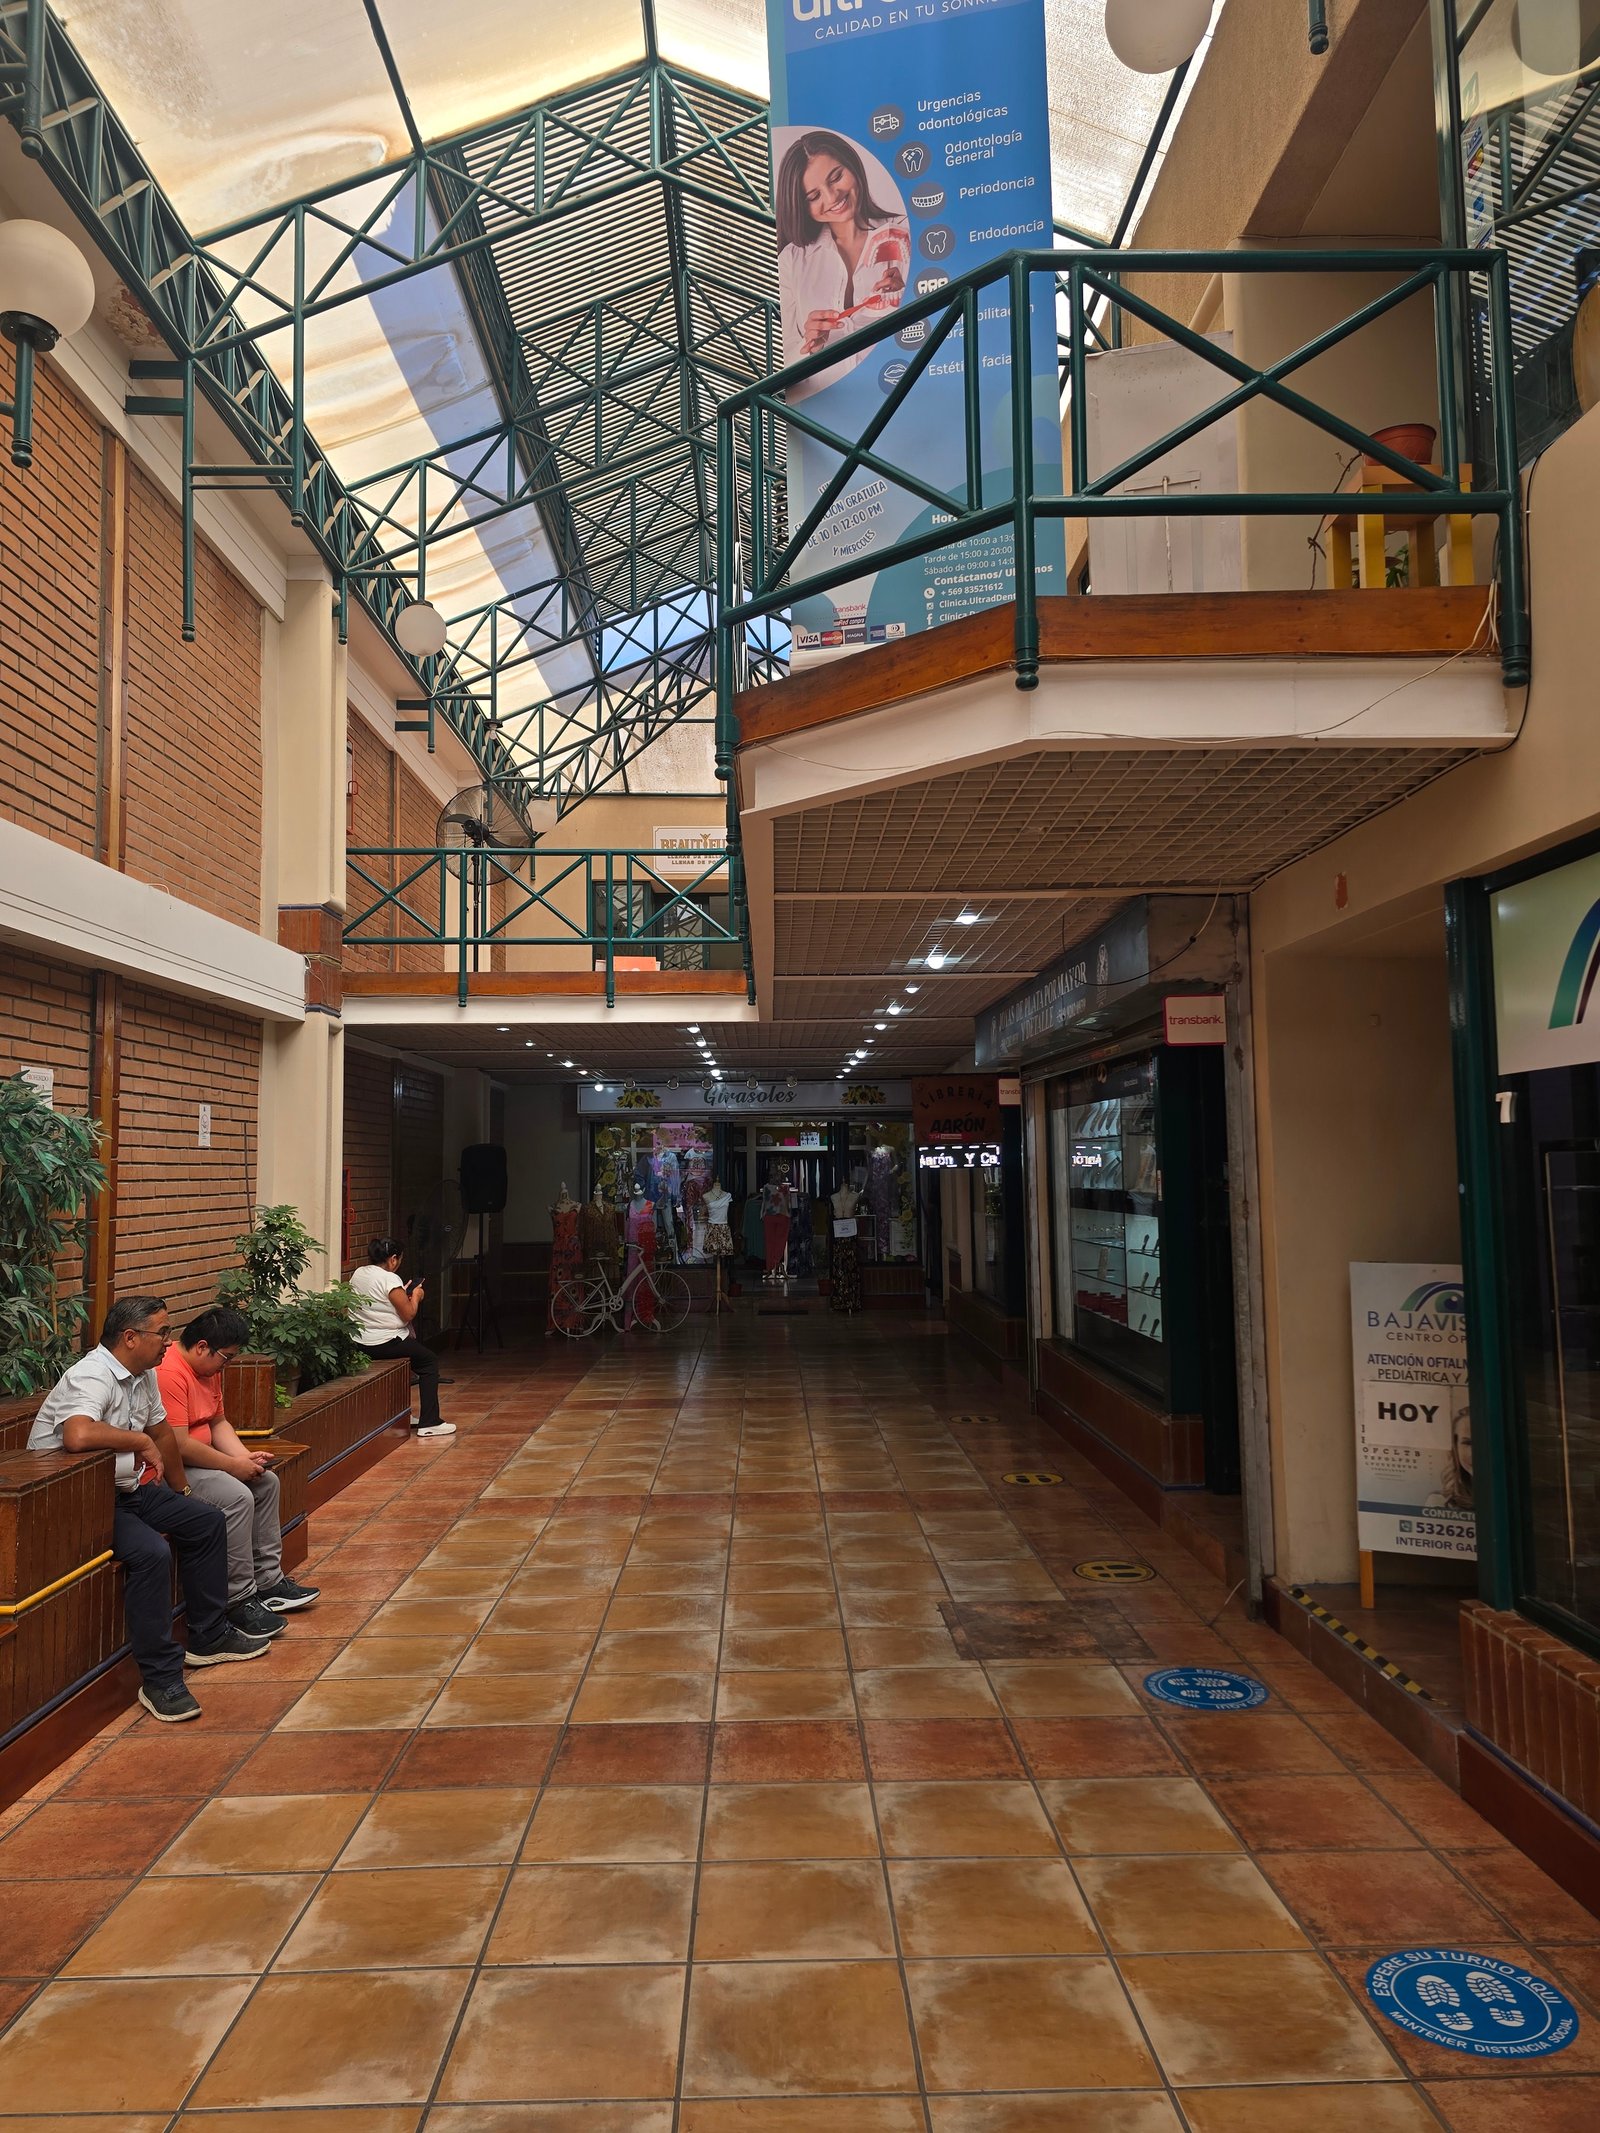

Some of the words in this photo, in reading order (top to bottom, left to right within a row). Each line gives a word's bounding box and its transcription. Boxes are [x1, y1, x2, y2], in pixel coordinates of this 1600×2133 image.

[814, 15, 882, 40] CALIDAD
[889, 9, 908, 24] EN
[915, 4, 935, 18] TU
[941, 0, 999, 13] SON
[917, 91, 982, 112] Urgencias
[918, 106, 1009, 131] odontológicas
[945, 130, 1023, 155] Odontología
[945, 147, 995, 167] General
[959, 176, 1035, 199] Periodoncia
[969, 219, 1045, 243] Endodoncia
[928, 359, 964, 376] Estéti
[981, 353, 1012, 369] facia
[845, 480, 887, 508] GRATUITA
[808, 534, 819, 549] DE
[819, 528, 830, 542] 10
[832, 524, 841, 536] A
[841, 511, 866, 531] 12:00
[867, 502, 883, 518] PM
[969, 537, 991, 547] 10:00
[923, 554, 946, 564] Tarde
[948, 553, 959, 561] de
[960, 550, 982, 560] 15:00
[990, 546, 1013, 556] 20:00
[924, 565, 954, 576] Sábado
[955, 563, 966, 572] de
[967, 560, 989, 571] 09:00
[998, 557, 1015, 566] 14:0
[934, 569, 1002, 586] Contáctanos/
[948, 587, 963, 596] 569
[964, 582, 1004, 594] 83521612
[800, 634, 819, 644] VISA
[1057, 961, 1087, 998] MAYOR
[703, 1085, 798, 1107] Girasoles
[930, 1112, 987, 1133] AARÓN
[964, 1153, 976, 1165] Y
[1367, 1310, 1468, 1332] BAJAVIS
[1386, 1331, 1443, 1343] CENTRO
[1367, 1353, 1424, 1368] ATENCIÓN
[1377, 1367, 1449, 1383] PEDIÁTRICA
[1451, 1372, 1461, 1383] Y
[1377, 1401, 1440, 1424] HOY
[1416, 1522, 1475, 1539] 532626
[1395, 1536, 1453, 1551] INTERIOR
[1372, 1956, 1407, 1997] ESPERE
[1404, 1951, 1433, 1963] SU
[1435, 1951, 1516, 1975] TURNO
[1389, 2010, 1468, 2050] MANTENER
[1474, 2041, 1552, 2055] DISTANCIA
[1547, 2018, 1573, 2044] SOCIAL
